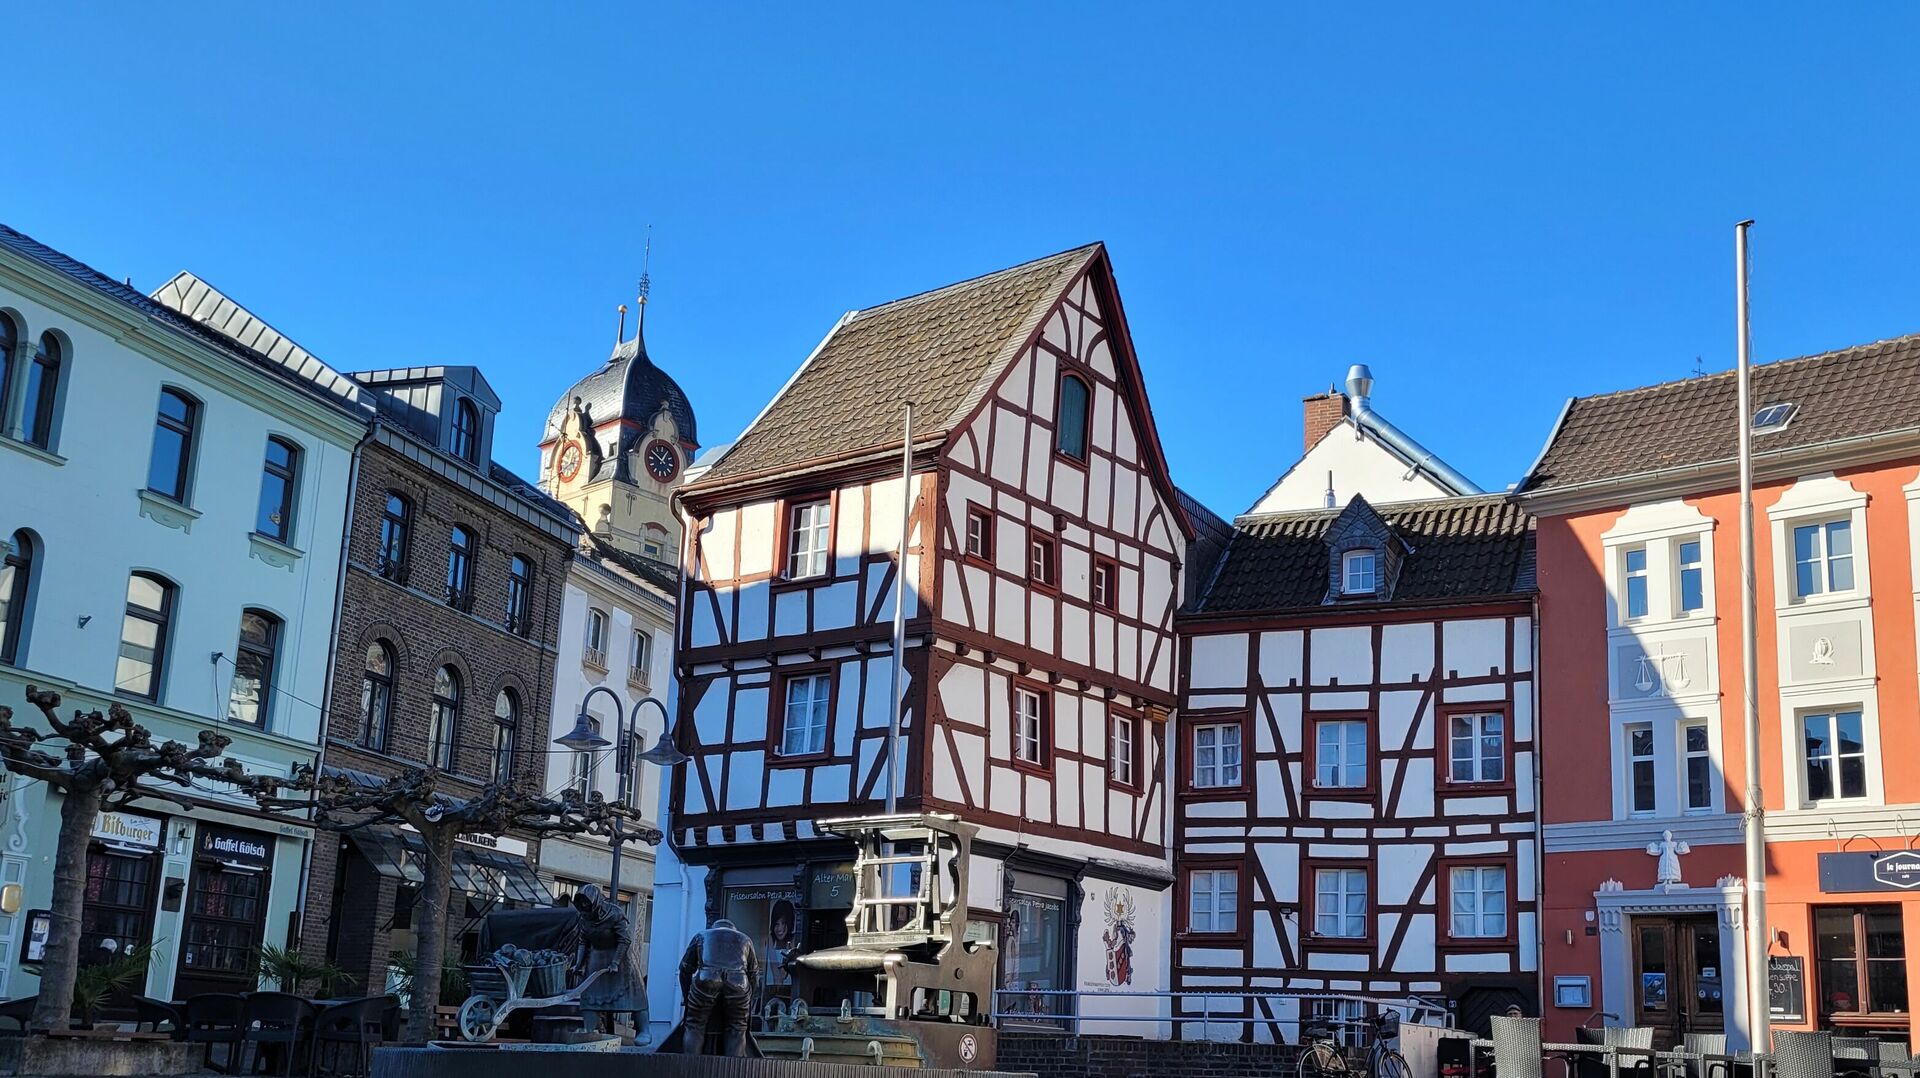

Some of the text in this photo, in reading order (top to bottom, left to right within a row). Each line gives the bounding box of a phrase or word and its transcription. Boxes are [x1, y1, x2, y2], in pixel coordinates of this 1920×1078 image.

[101, 814, 154, 841] Bitburger
[214, 837, 265, 858] Gaffel Kölsch
[814, 873, 853, 884] Alter Mar
[829, 885, 841, 898] 5
